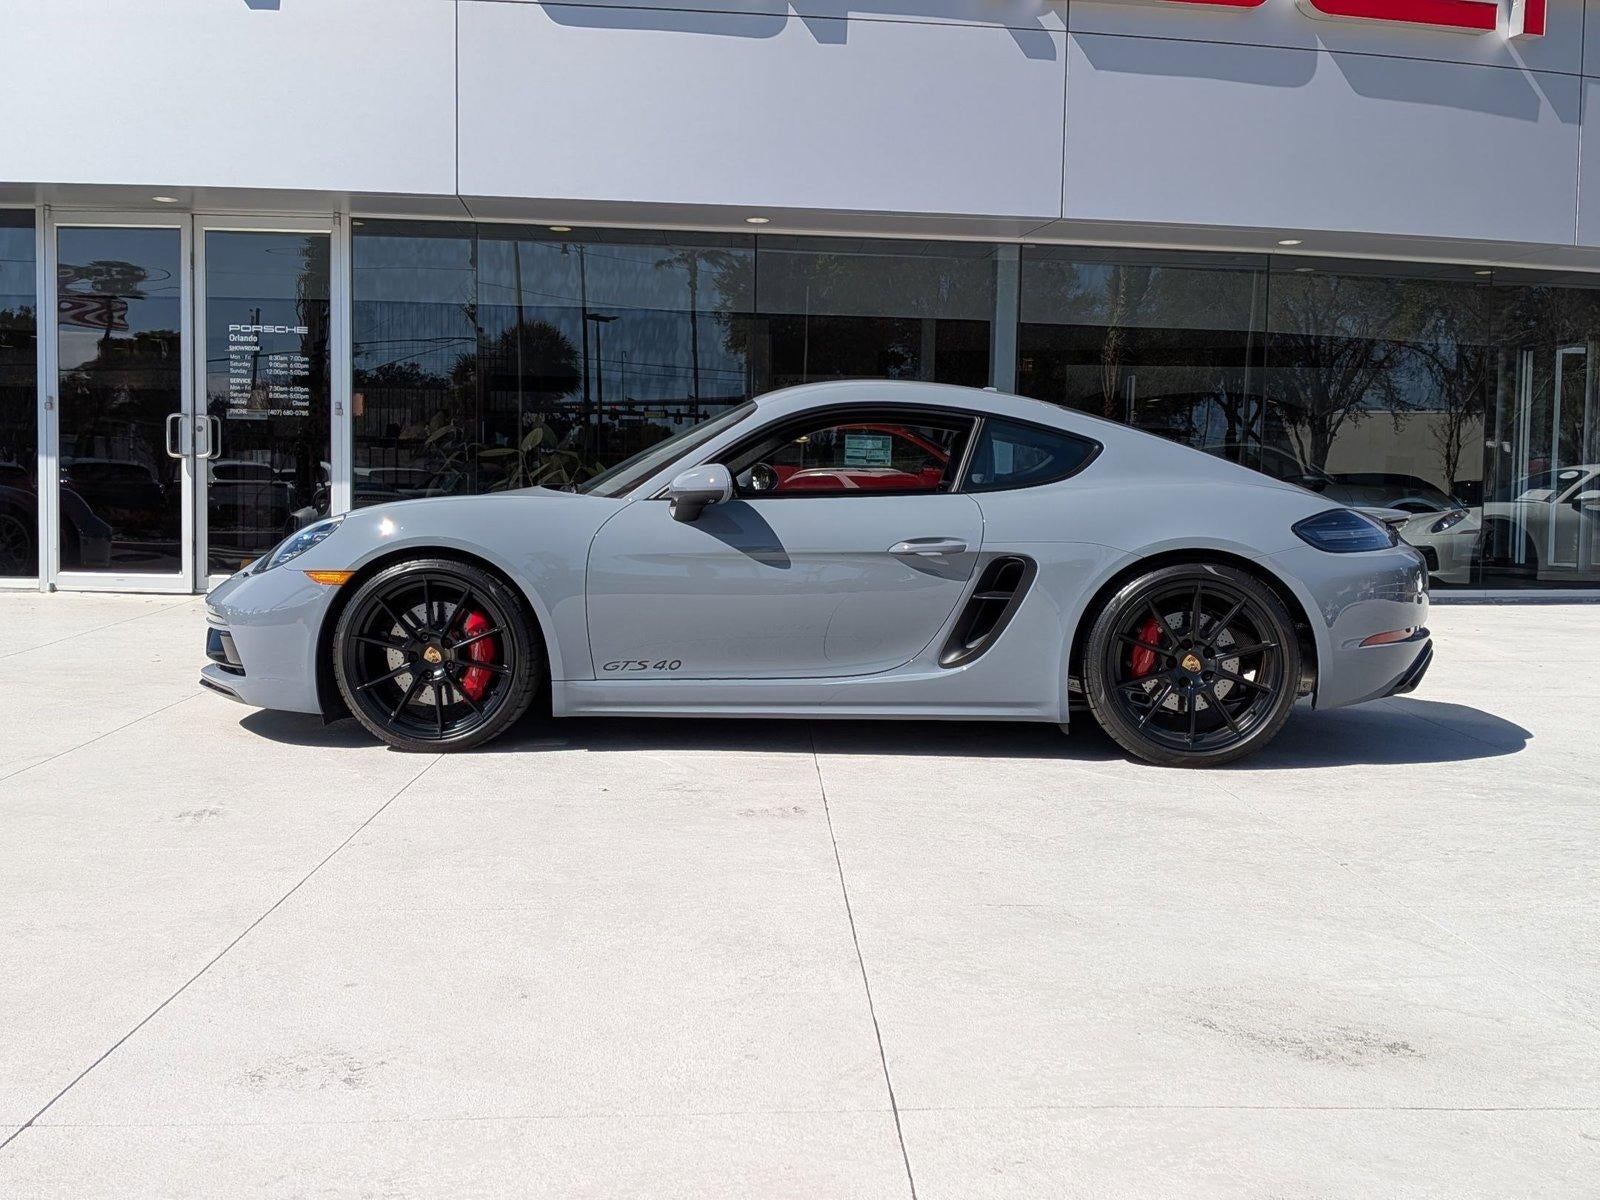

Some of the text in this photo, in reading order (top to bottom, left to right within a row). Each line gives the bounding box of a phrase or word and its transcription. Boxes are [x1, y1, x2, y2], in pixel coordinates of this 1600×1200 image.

[228, 324, 309, 334] PORSCHE
[228, 334, 258, 342] Orlando
[602, 659, 682, 671] GTS 4.0
